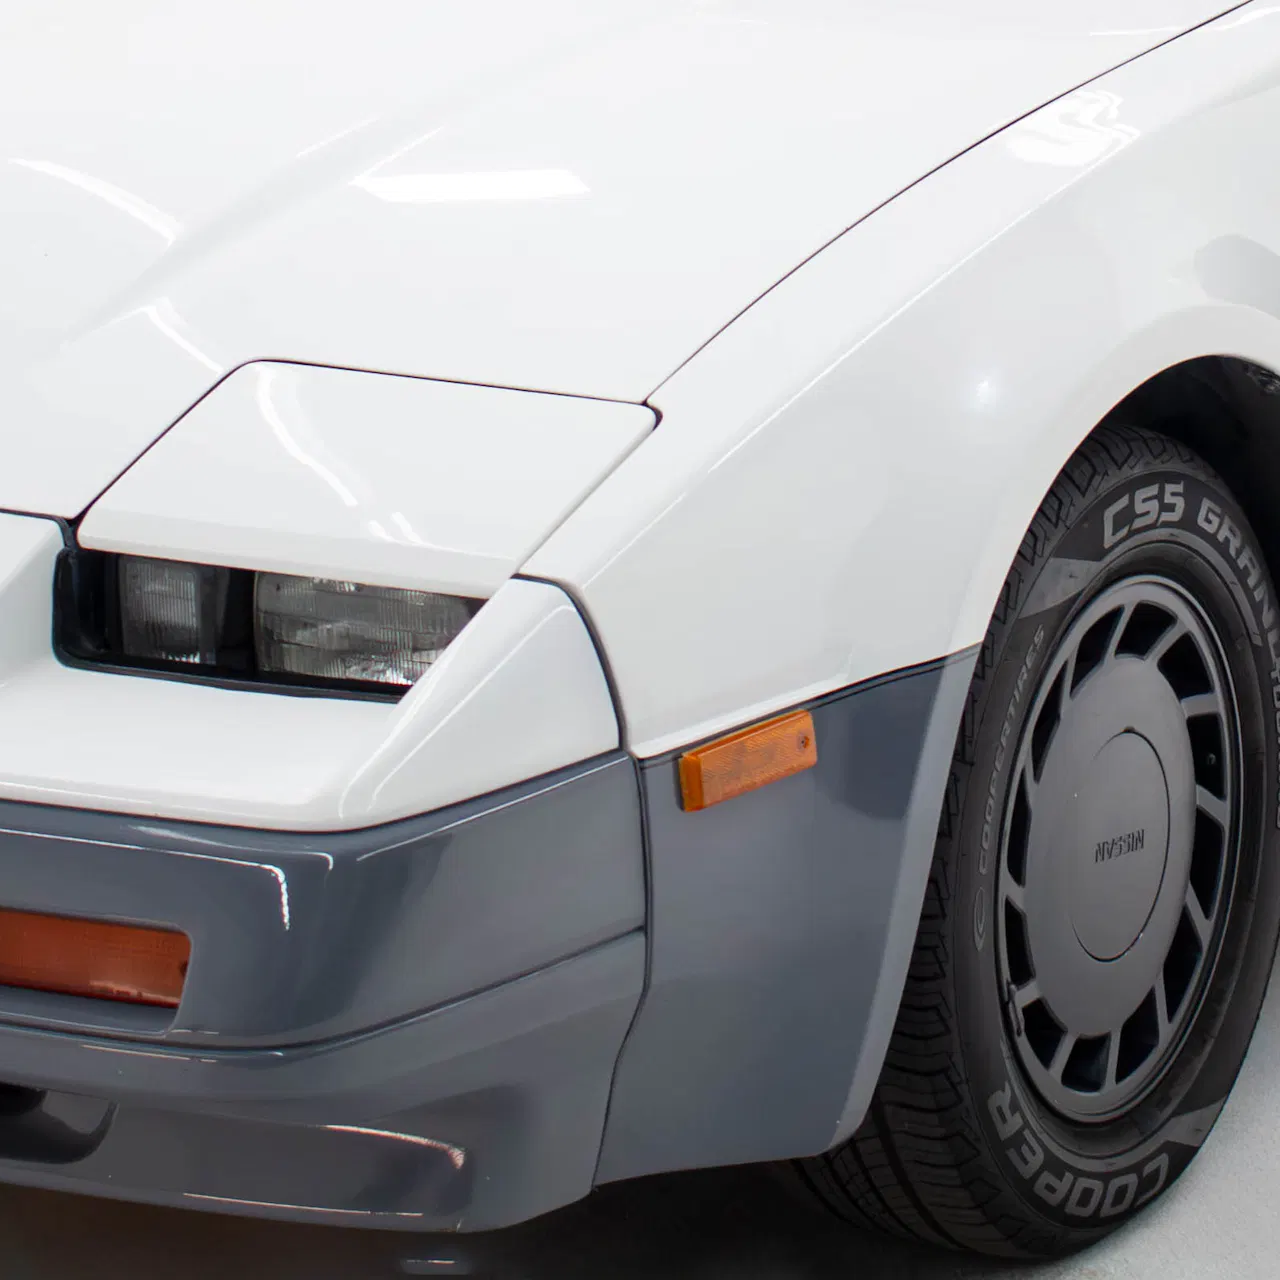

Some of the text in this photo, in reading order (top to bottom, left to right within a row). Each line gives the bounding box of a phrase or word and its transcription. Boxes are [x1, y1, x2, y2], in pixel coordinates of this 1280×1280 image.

[1104, 481, 1184, 548] CS5
[1095, 828, 1144, 863] NISSAN
[987, 1081, 1169, 1218] COOPER
